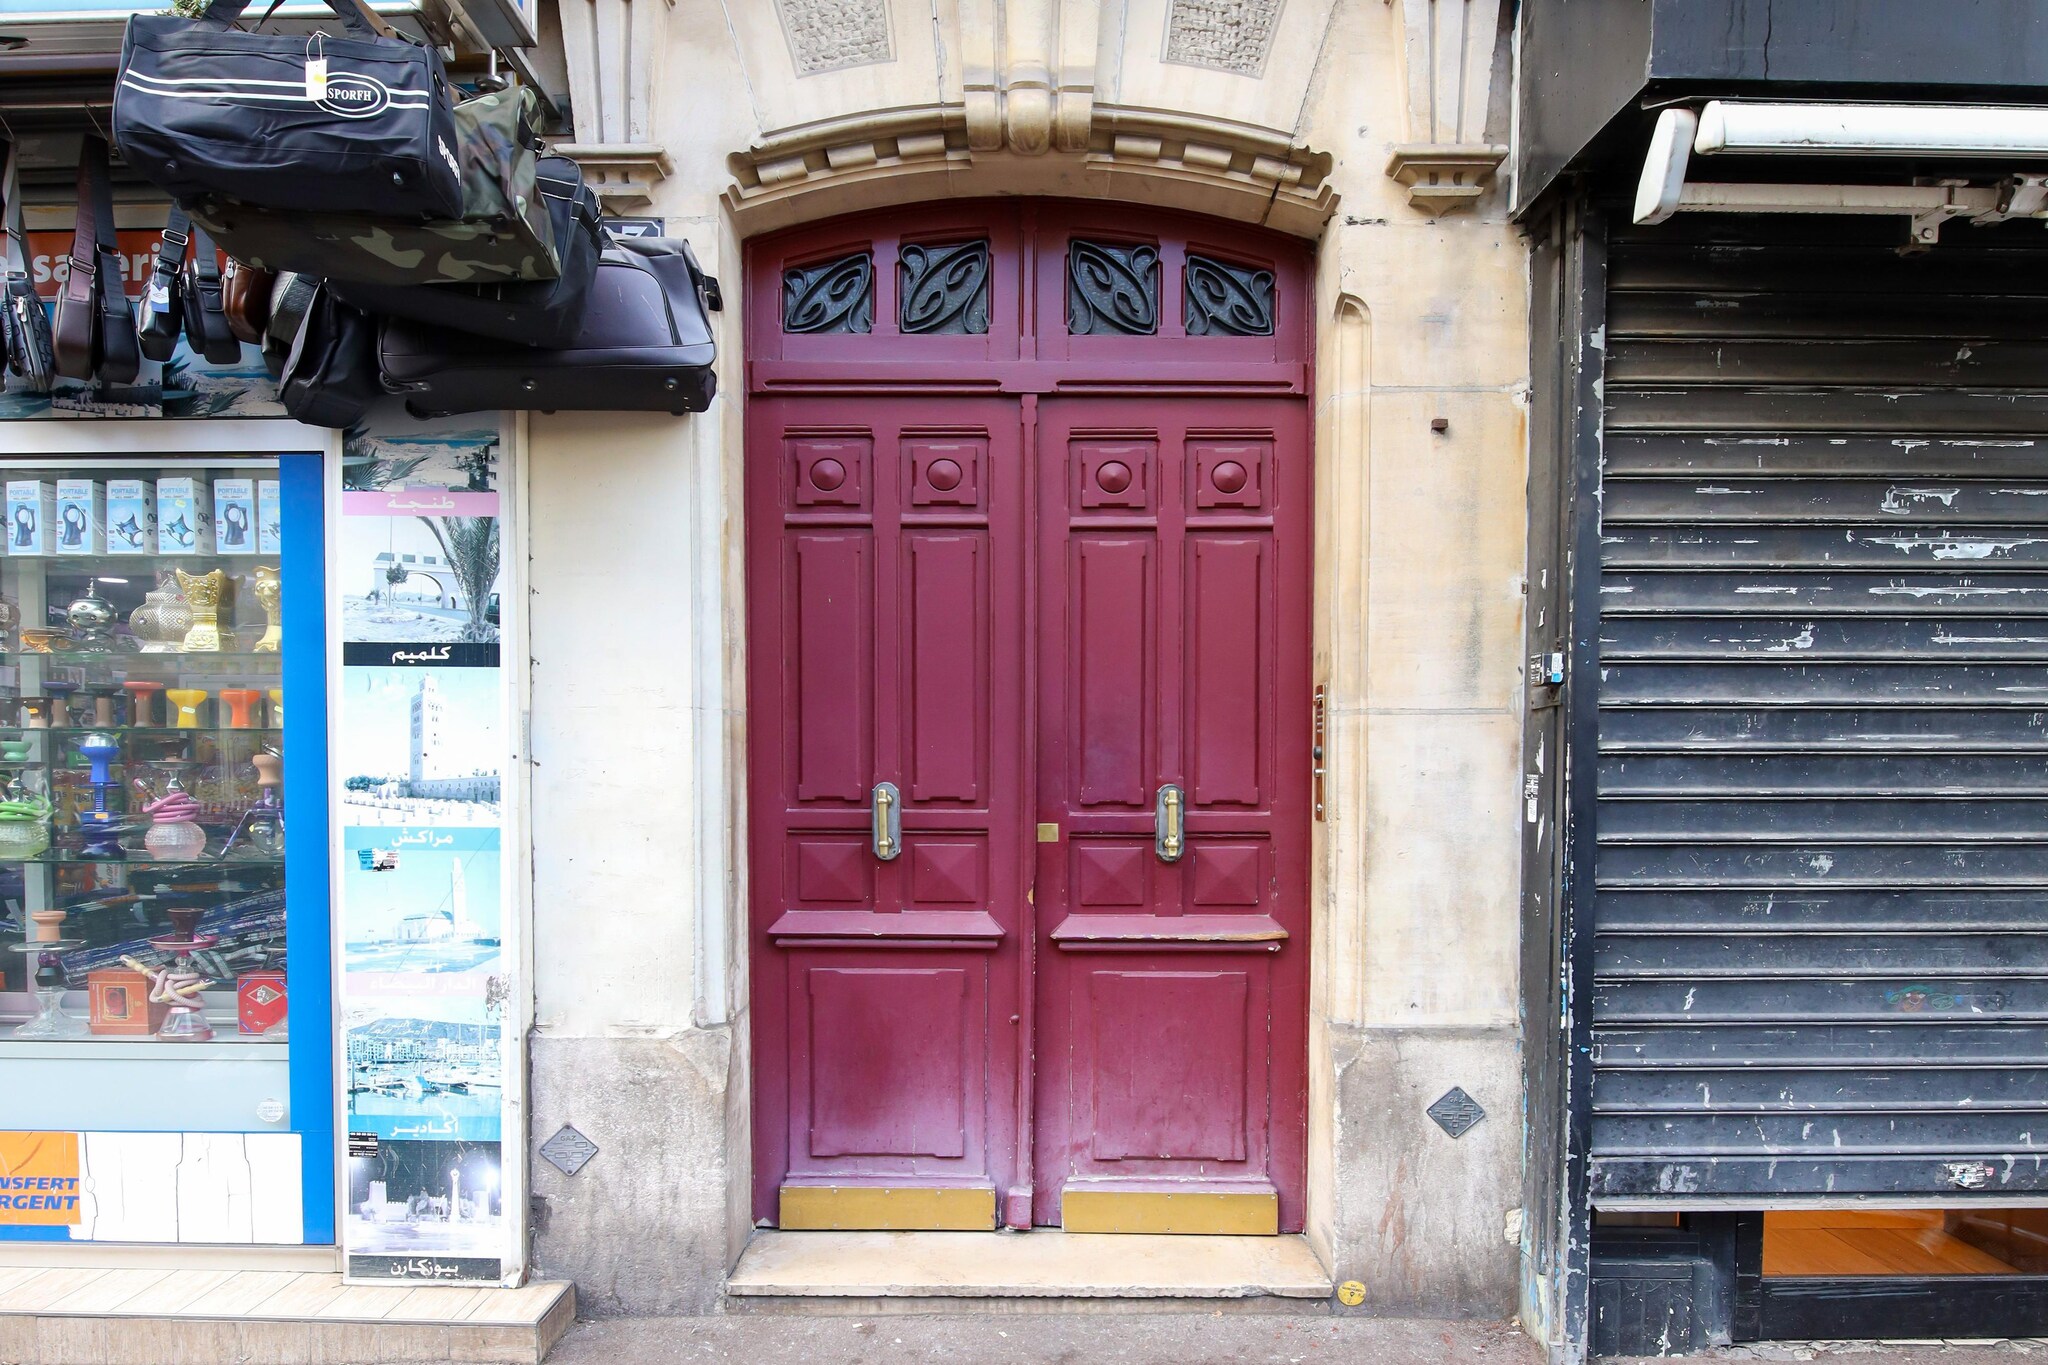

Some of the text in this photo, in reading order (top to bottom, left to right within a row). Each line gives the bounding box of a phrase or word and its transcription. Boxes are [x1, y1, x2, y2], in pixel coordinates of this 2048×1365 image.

[328, 87, 372, 102] SPORFH
[387, 494, 455, 512] طنجة
[392, 646, 451, 664] كلميم
[391, 827, 453, 847] مراكش
